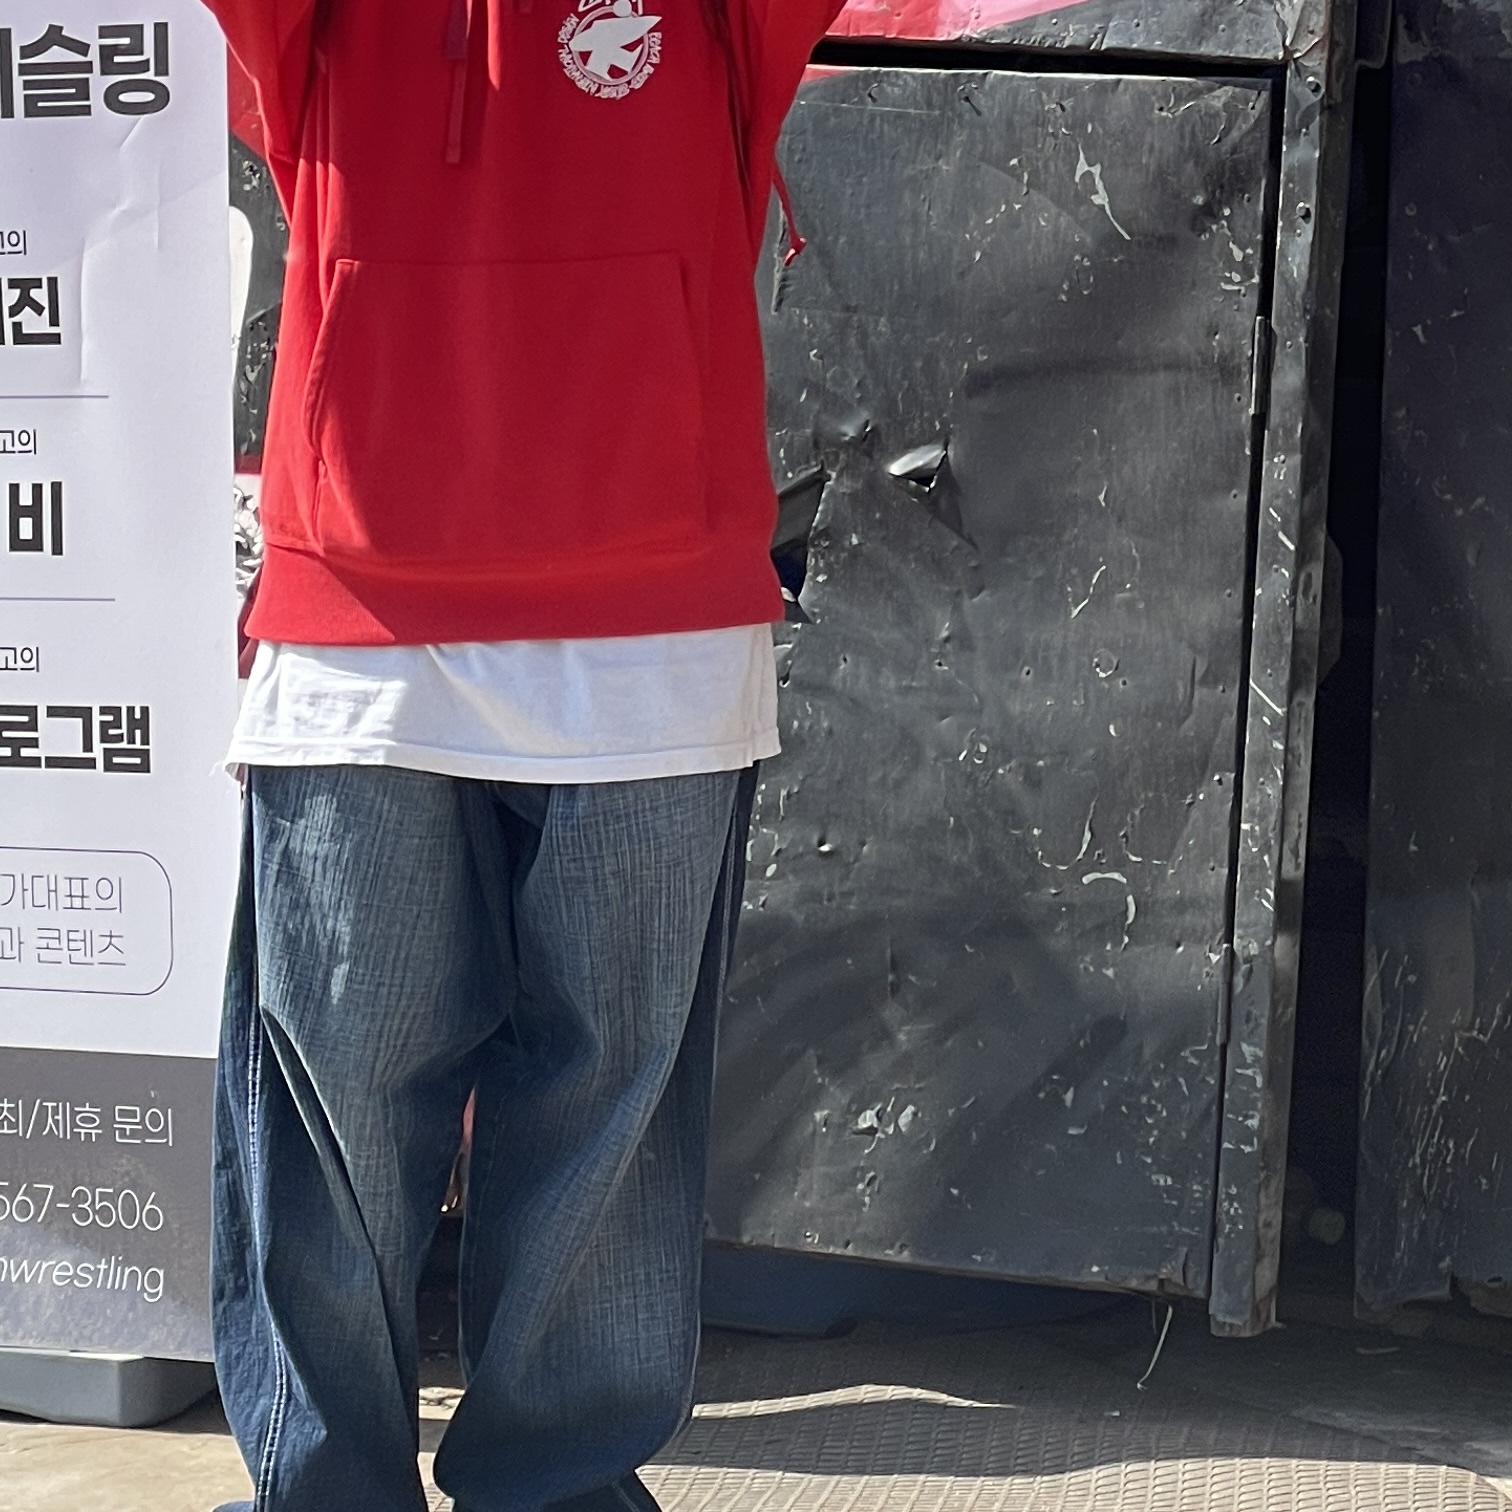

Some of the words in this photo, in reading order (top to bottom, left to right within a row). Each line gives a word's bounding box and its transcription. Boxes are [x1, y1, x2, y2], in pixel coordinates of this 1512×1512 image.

[0, 21, 170, 119] 슬링
[0, 230, 27, 255] 의
[0, 276, 61, 346] 진
[0, 429, 37, 455] 고의
[0, 646, 40, 672] 고의
[0, 704, 151, 773] 로그램
[0, 872, 122, 913] 가대표의
[0, 926, 25, 964] 과
[35, 927, 126, 966] 콘텐츠
[113, 1104, 173, 1147] 문의
